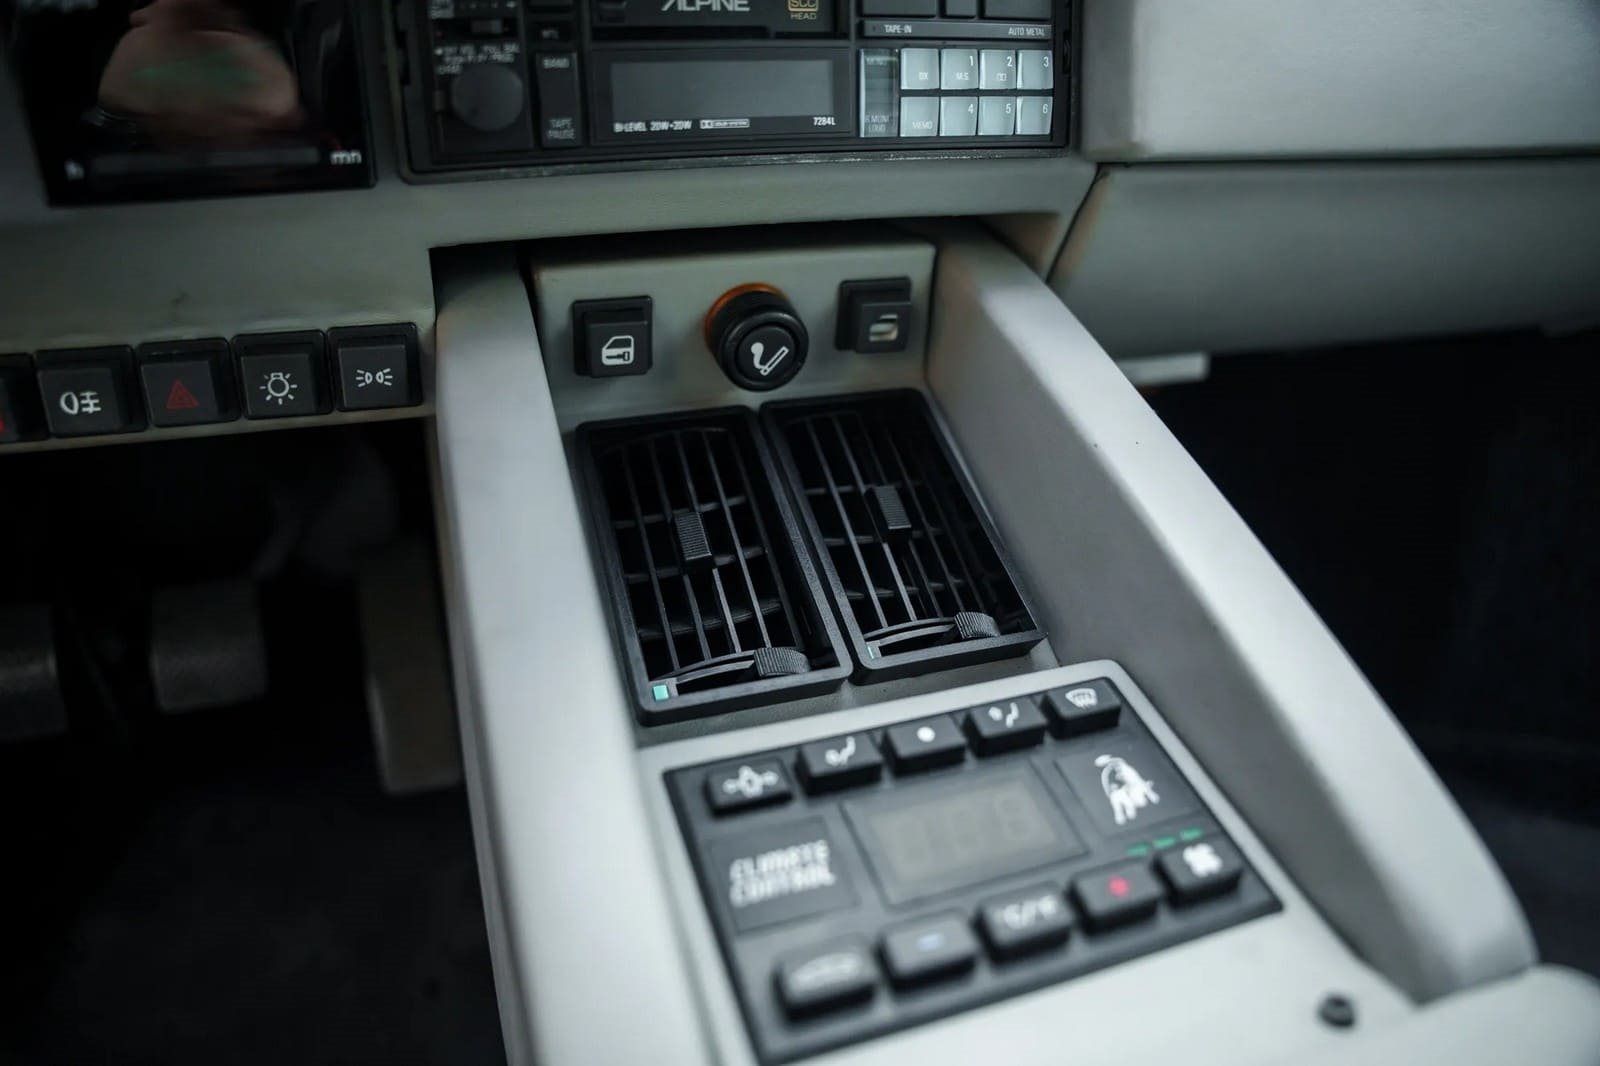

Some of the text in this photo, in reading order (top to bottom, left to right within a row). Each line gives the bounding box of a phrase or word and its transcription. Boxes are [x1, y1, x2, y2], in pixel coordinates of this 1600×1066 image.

[884, 24, 912, 34] TAPE-IN
[1008, 27, 1045, 36] AUTO METAL
[969, 56, 974, 67] 1
[1006, 56, 1013, 67] 2
[1043, 56, 1049, 68] 3
[968, 103, 974, 114] 4
[1005, 103, 1011, 114] 5
[1042, 103, 1048, 114] 6
